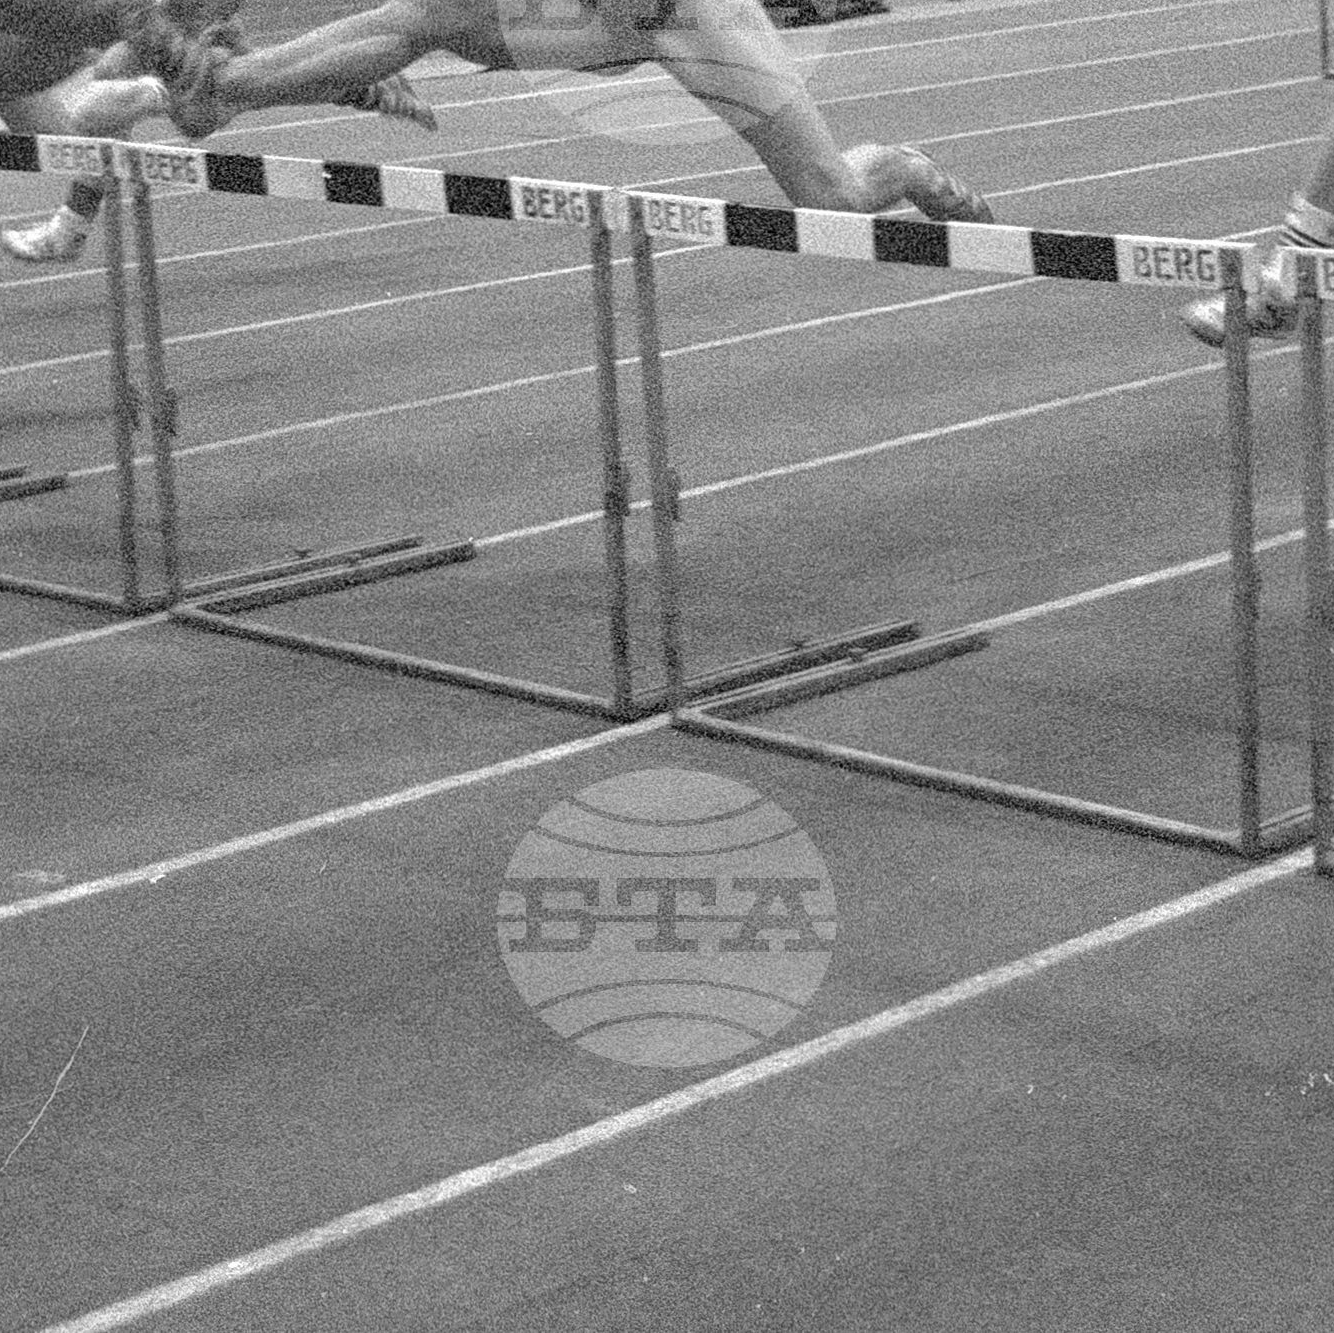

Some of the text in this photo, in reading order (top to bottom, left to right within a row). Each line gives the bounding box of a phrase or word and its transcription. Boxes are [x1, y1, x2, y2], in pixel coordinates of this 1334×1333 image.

[522, 186, 585, 223] BERG
[649, 199, 716, 237] BERG
[1132, 246, 1217, 282] BERG
